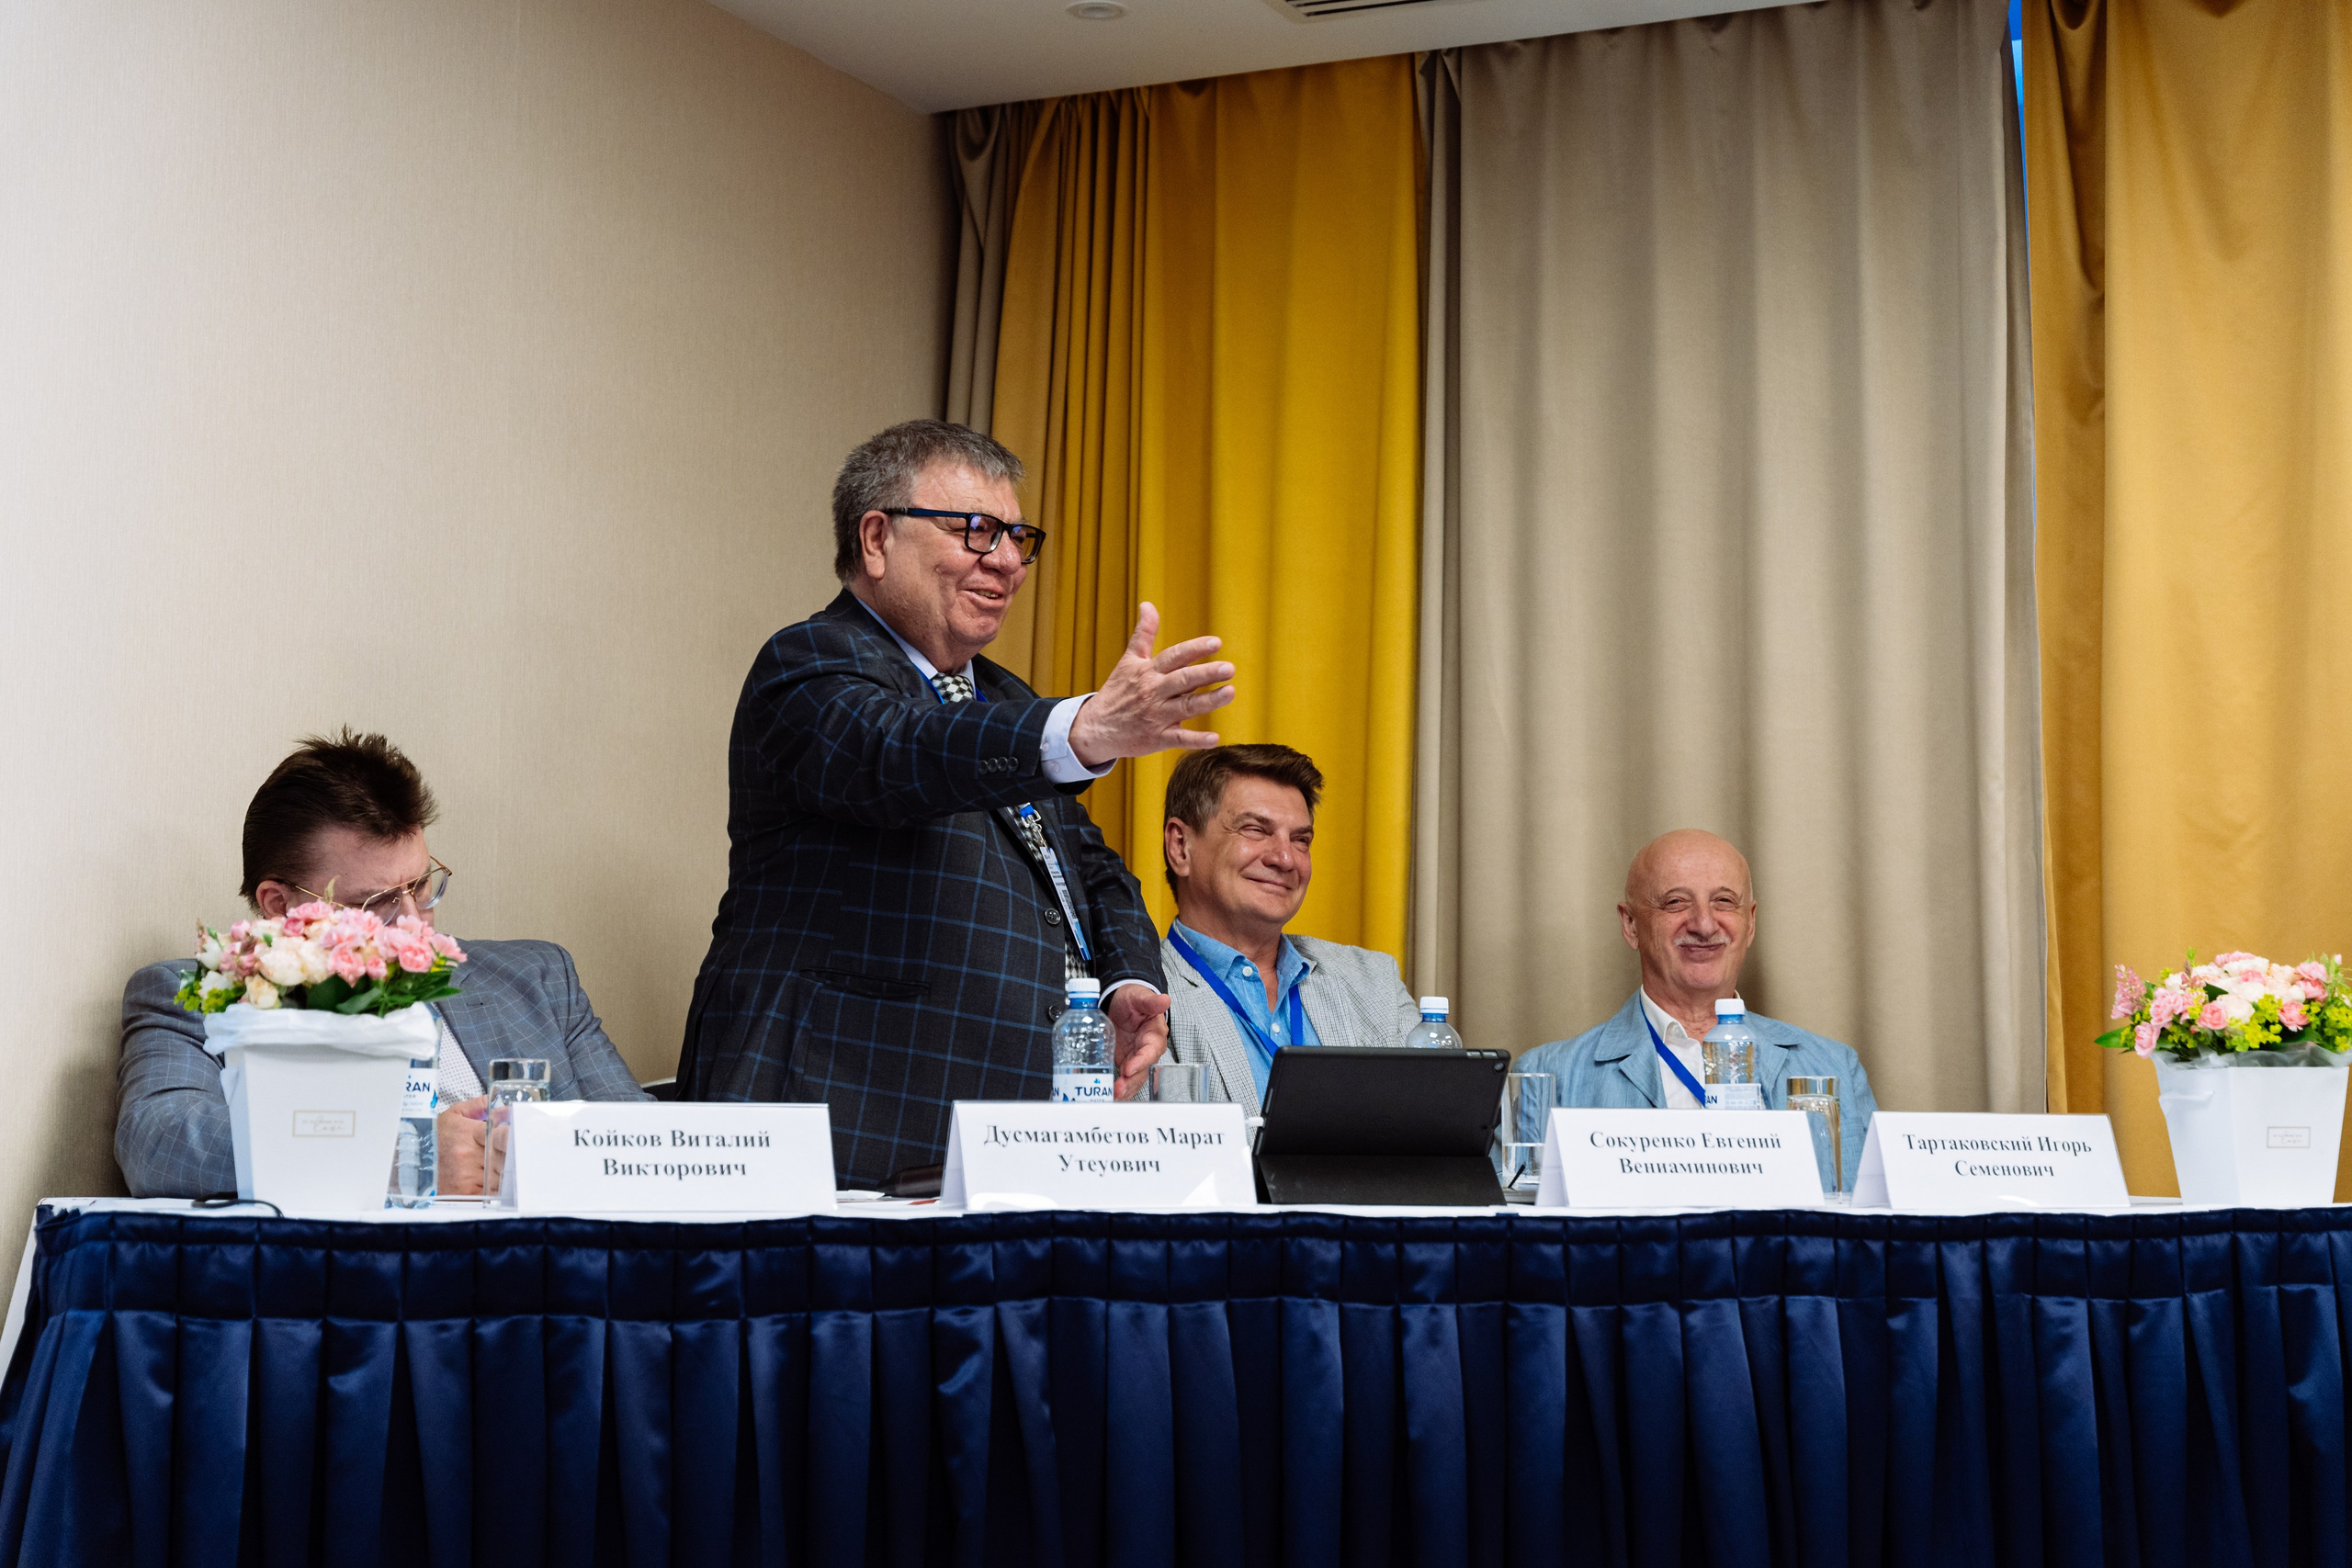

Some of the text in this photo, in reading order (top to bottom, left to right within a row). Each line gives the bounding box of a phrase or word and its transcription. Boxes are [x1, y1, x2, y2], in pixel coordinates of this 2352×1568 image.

[406, 1081, 431, 1092] RAN
[1075, 1086, 1113, 1097] TURAN
[573, 1129, 771, 1148] Койков Виталий
[983, 1125, 1225, 1150] Дусмагамбетов Марат
[1590, 1131, 1781, 1153] Сокуренко Евгений
[1903, 1134, 2092, 1157] Тартаковский Игорь
[603, 1158, 746, 1181] Викторович
[1058, 1155, 1160, 1178] Утеуович
[1619, 1157, 1764, 1175] Вениаминович
[1954, 1159, 2054, 1177] Семенович
